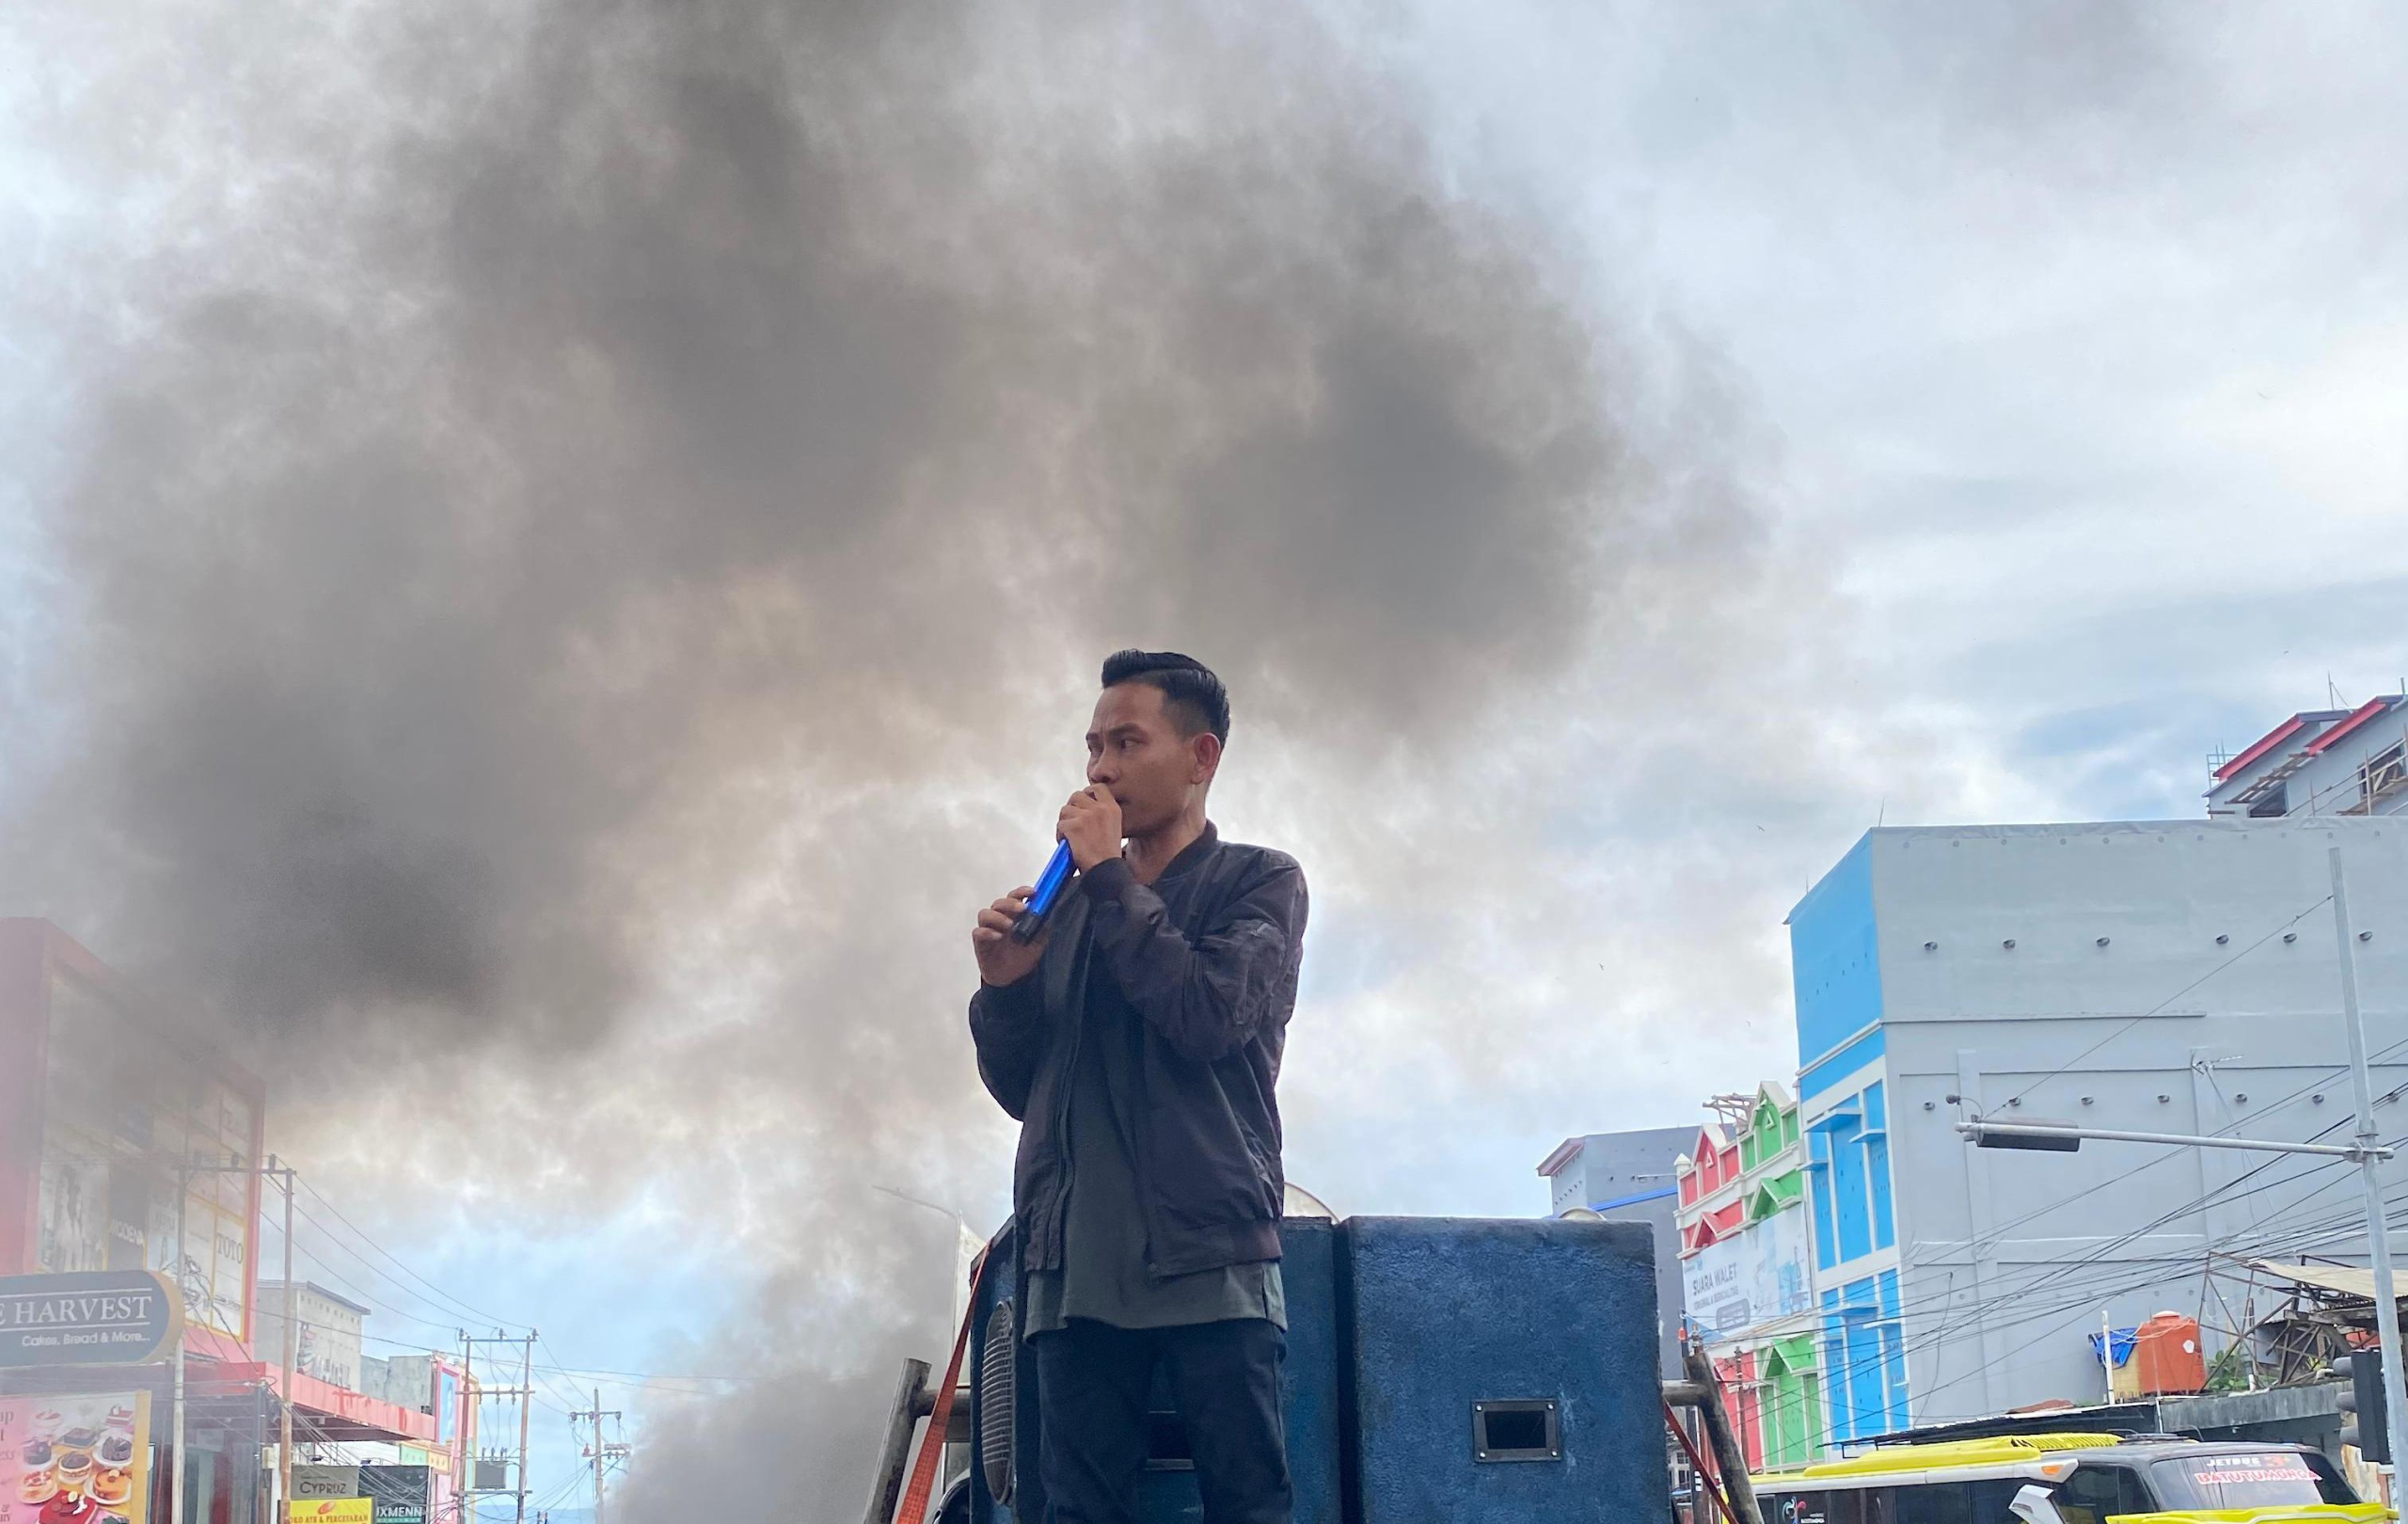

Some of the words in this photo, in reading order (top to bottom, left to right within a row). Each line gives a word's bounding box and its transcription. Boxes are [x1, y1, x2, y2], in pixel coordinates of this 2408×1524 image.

[216, 1232, 244, 1264] TOTO
[1693, 1272, 1714, 1296] SUARA
[1713, 1262, 1737, 1287] WALET
[14, 1296, 152, 1325] HARVEST
[63, 1332, 98, 1345] Bread
[101, 1332, 109, 1343] &
